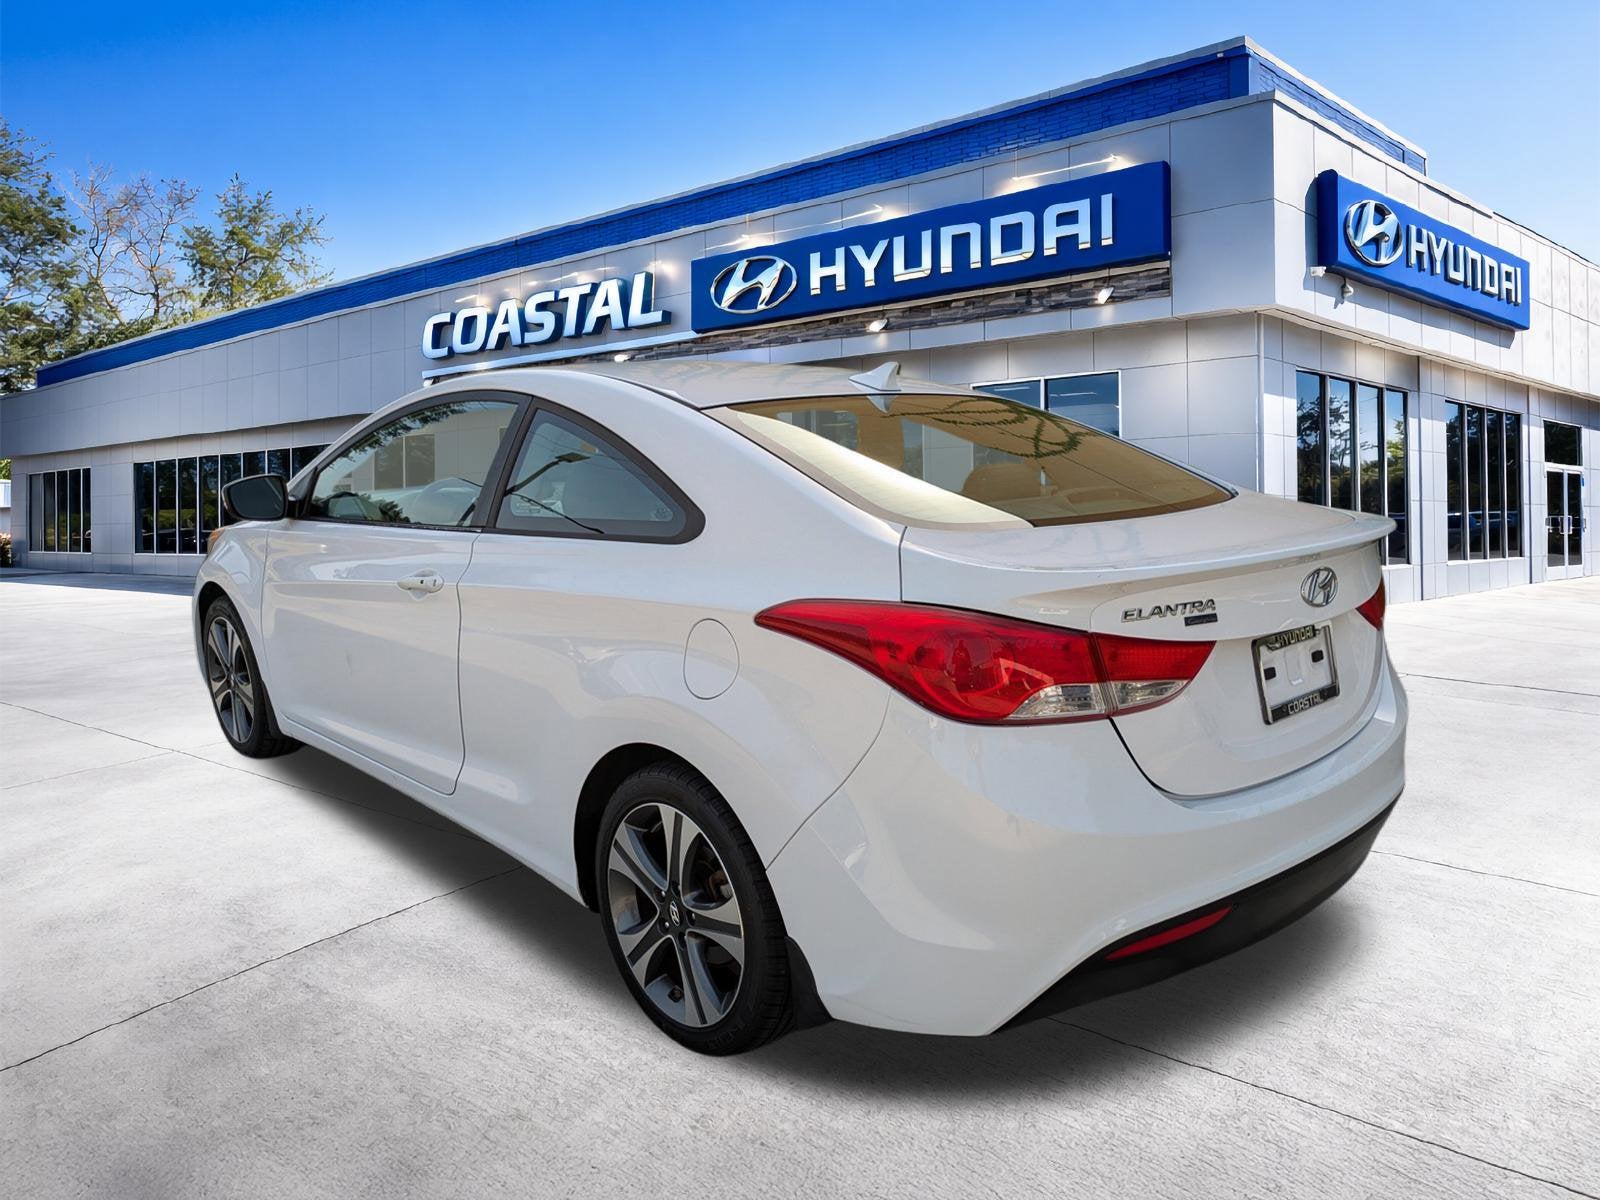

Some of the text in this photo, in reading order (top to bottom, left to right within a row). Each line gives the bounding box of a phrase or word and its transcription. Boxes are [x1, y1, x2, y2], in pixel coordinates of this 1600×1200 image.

[809, 193, 1114, 296] HYUNDAI
[1406, 224, 1523, 306] HYUNDAI
[422, 271, 667, 359] COASTAL
[1121, 598, 1216, 623] ELANTRA
[1278, 626, 1314, 647] HYUNDAI
[1287, 693, 1325, 714] COASTAL
